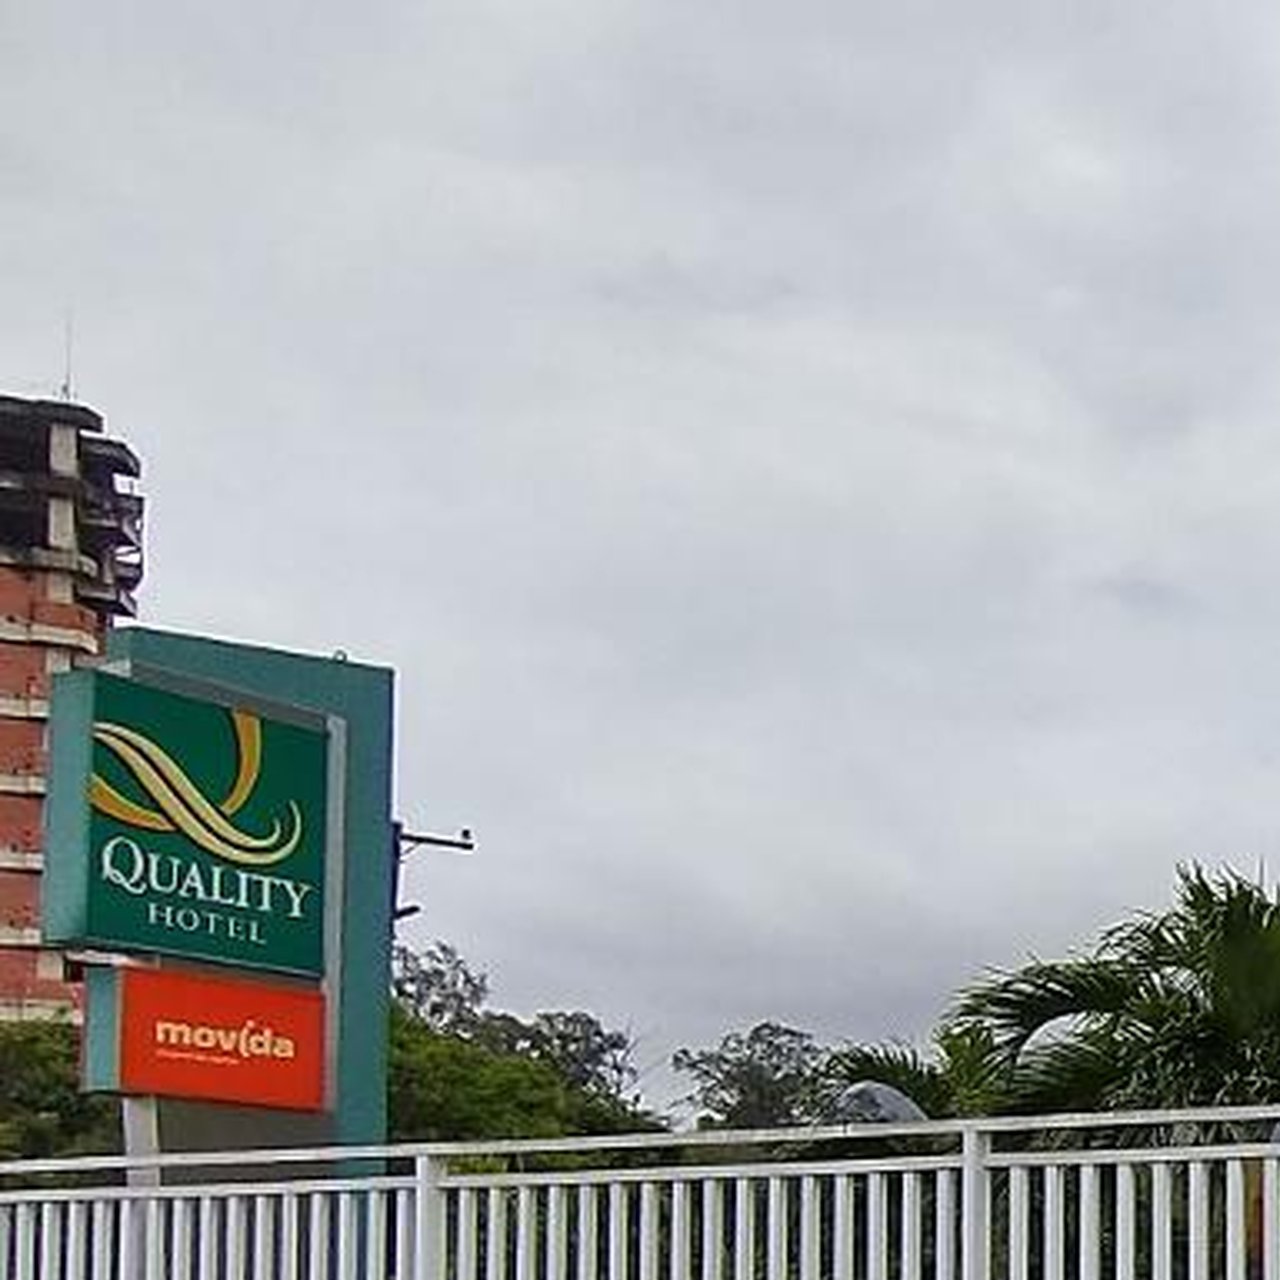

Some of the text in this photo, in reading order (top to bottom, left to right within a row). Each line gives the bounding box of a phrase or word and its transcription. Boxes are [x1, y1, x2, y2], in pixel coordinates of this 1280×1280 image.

[102, 836, 313, 918] QUALITY
[148, 902, 267, 945] HOTEL
[156, 1019, 295, 1058] movida
